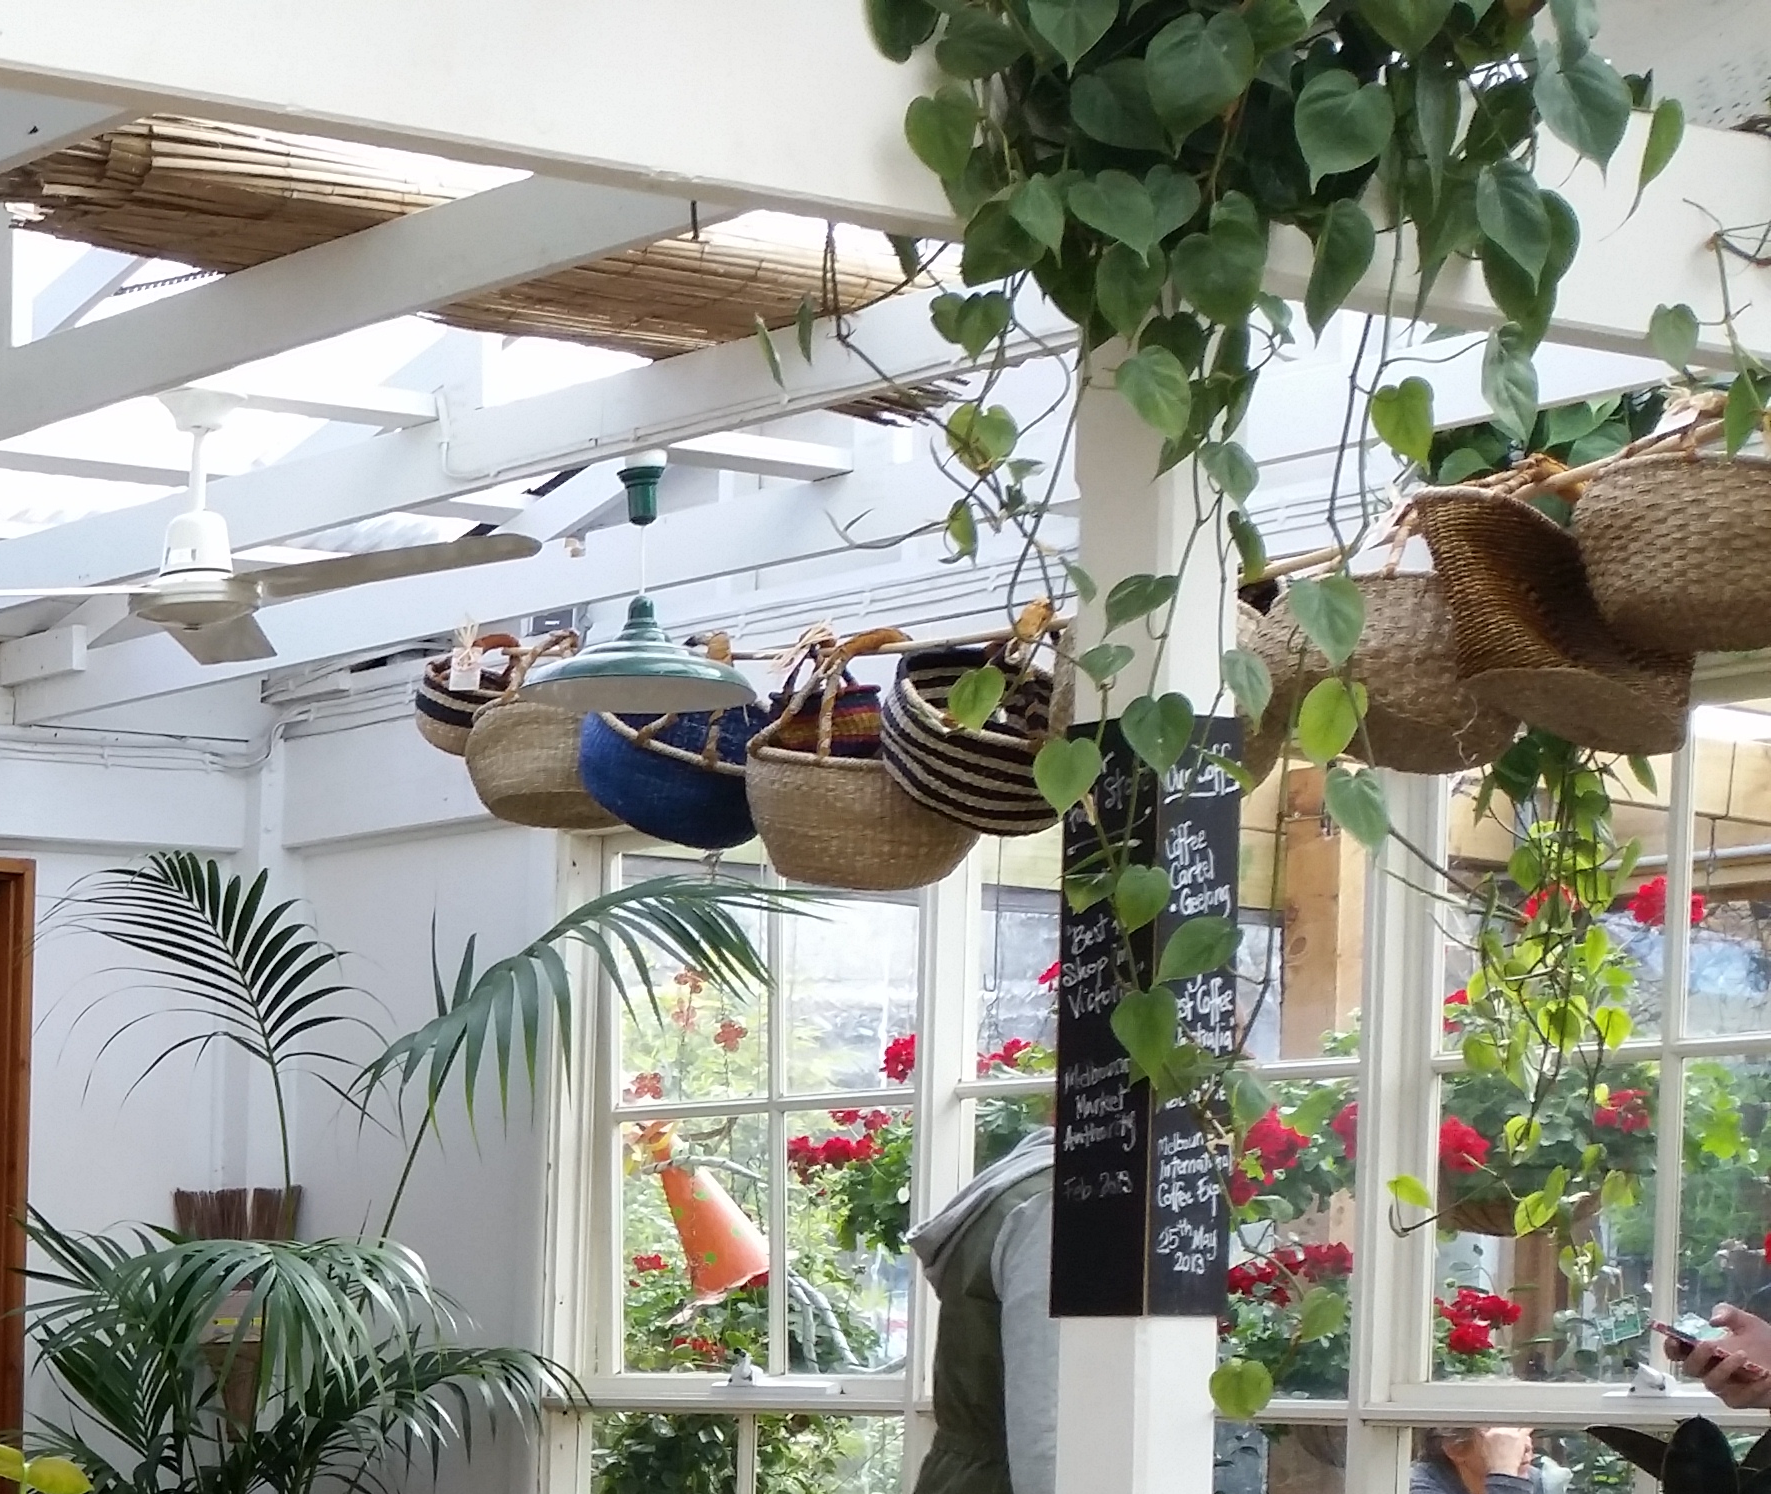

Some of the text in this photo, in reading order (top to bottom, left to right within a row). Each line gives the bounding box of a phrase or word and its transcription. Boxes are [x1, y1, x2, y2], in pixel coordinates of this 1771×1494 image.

[1062, 955, 1109, 988] Shop
[1158, 1181, 1193, 1213] Coffee
[1191, 1225, 1219, 1261] May
